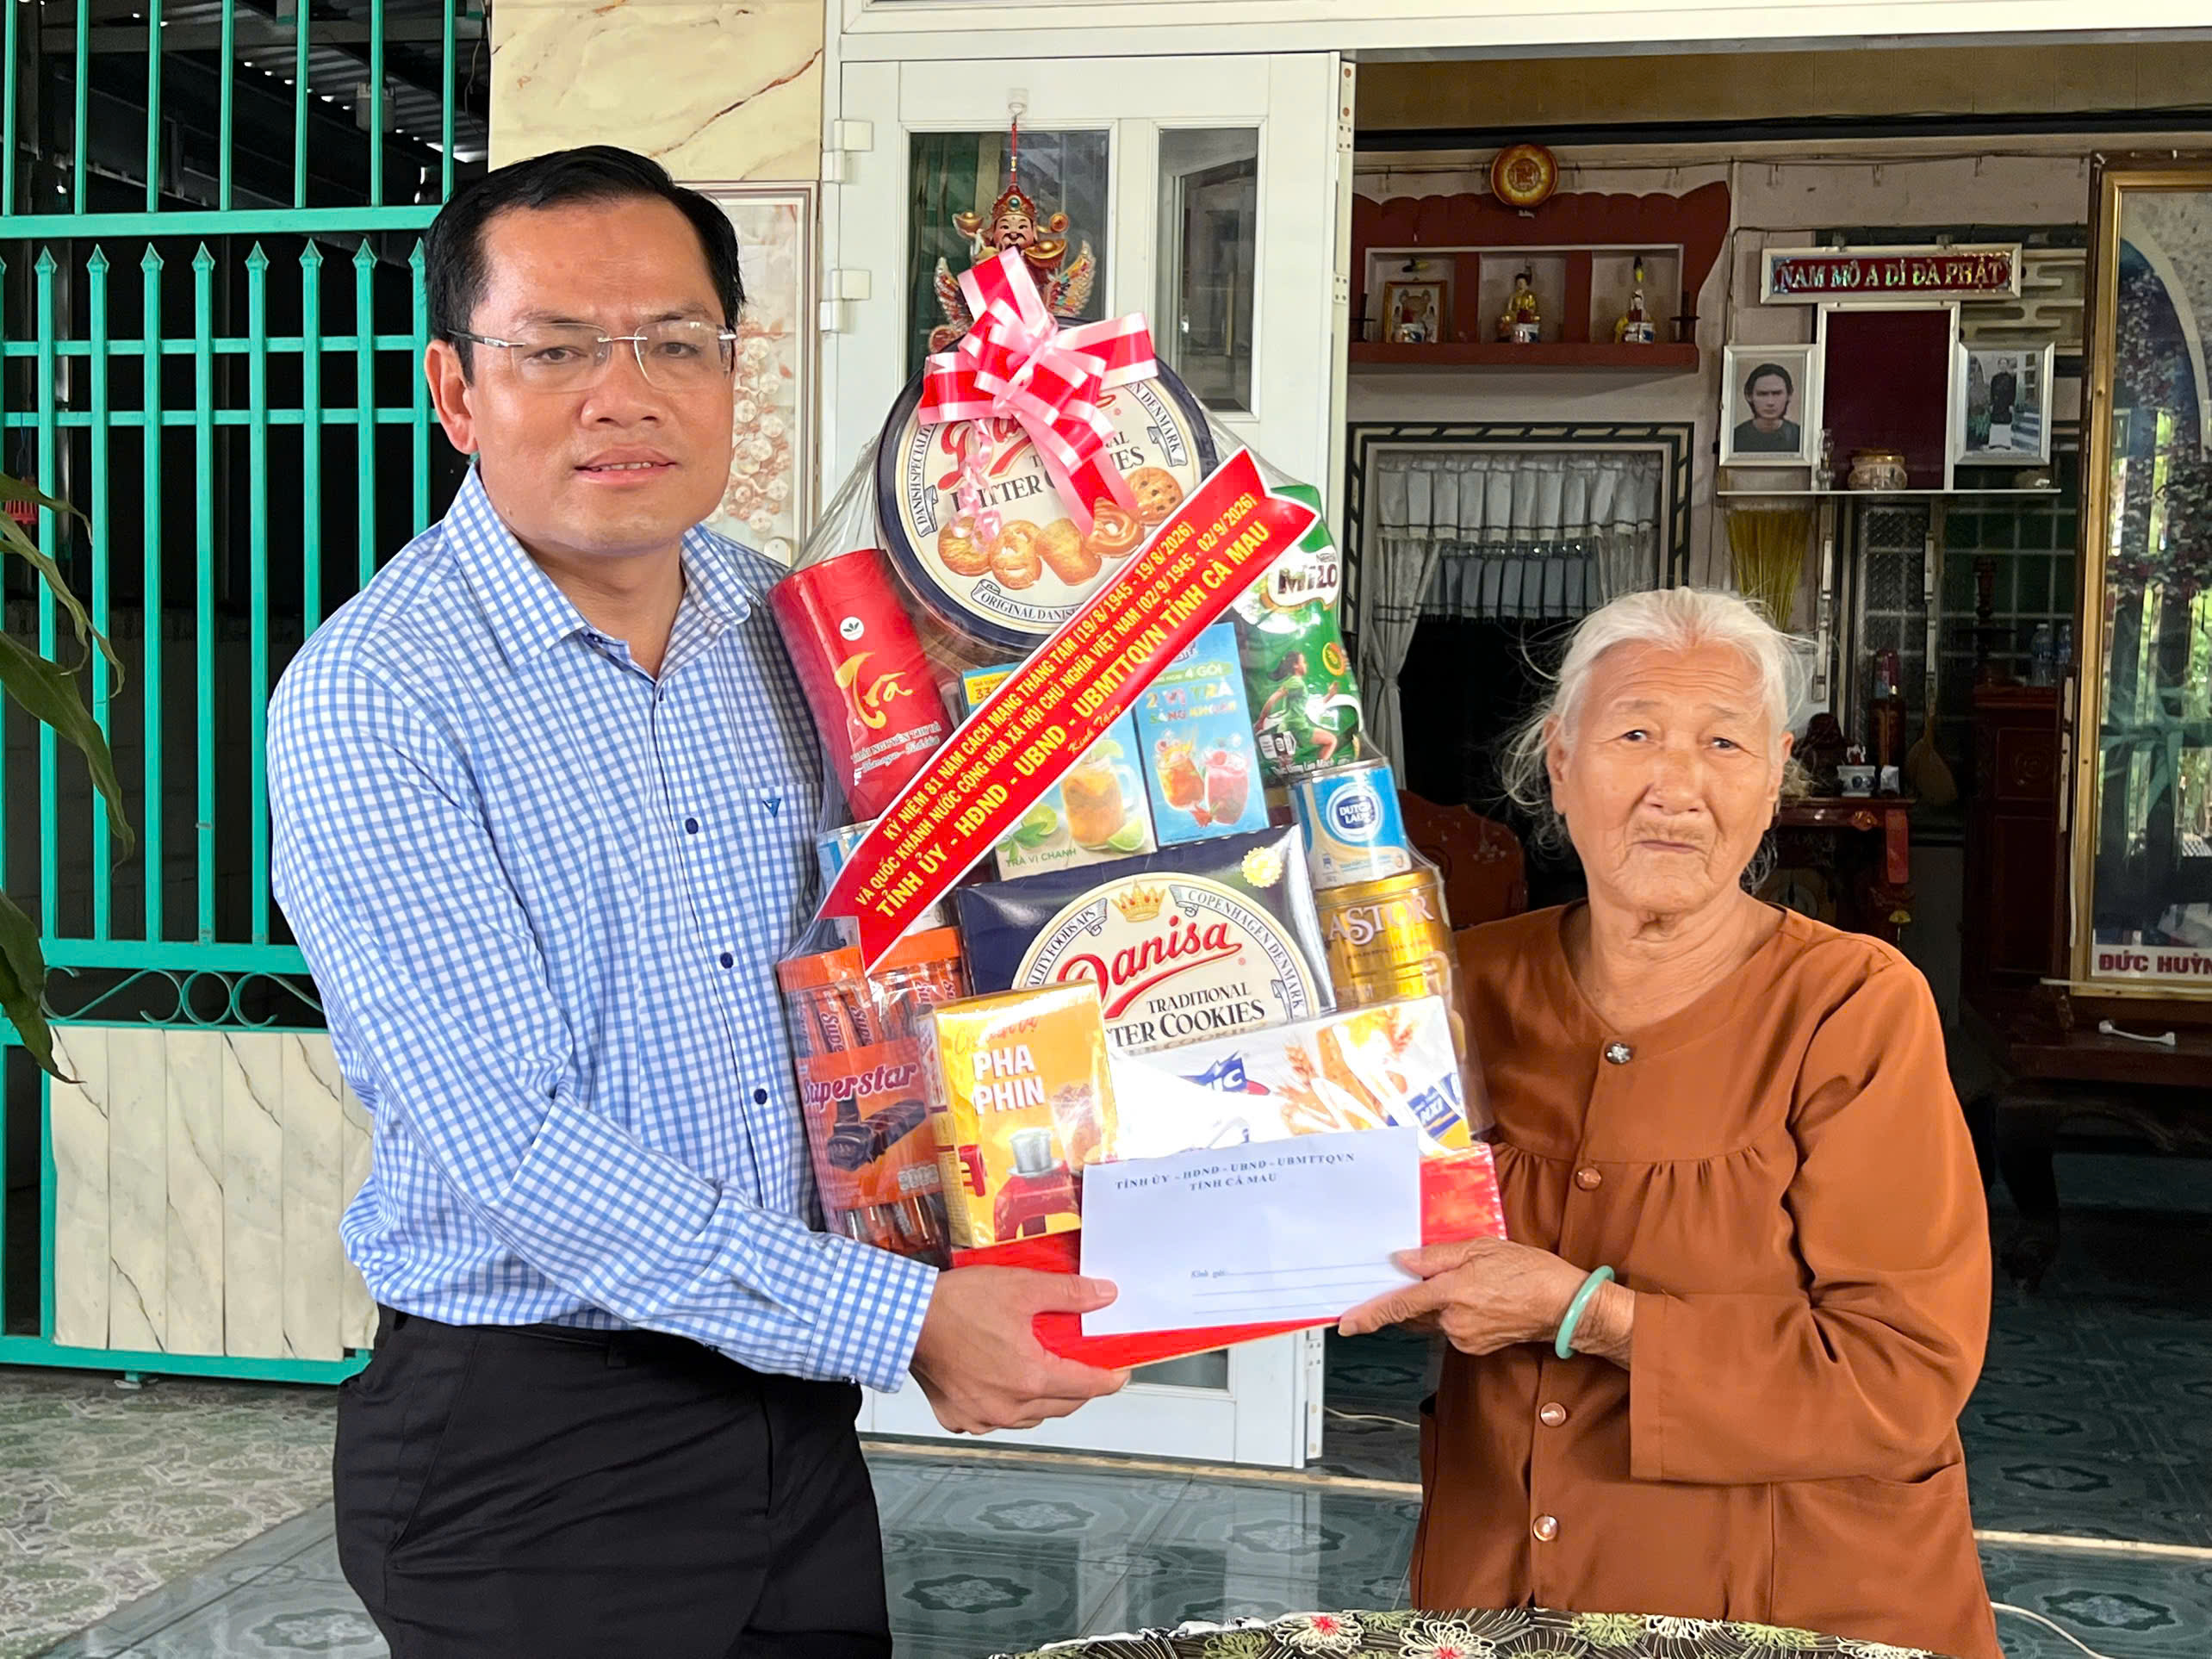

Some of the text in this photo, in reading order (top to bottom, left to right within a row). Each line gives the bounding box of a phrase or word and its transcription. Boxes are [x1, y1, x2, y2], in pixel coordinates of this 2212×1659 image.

[1780, 263, 1825, 289] NAM
[1830, 259, 1861, 288] MÔ
[1864, 264, 1879, 287] A
[1944, 258, 2003, 289] PHẬT
[1140, 391, 1181, 453] DENMARK
[910, 482, 928, 525] DANISH
[950, 475, 1043, 513] TTER
[981, 592, 1035, 619] ORIGINAL
[883, 818, 902, 841] KỶ
[898, 792, 929, 823] NIỆM
[924, 777, 943, 794] 81
[937, 751, 966, 779] NĂM
[961, 723, 993, 755] CÁCH
[988, 693, 1023, 728] MẠNG
[1016, 660, 1056, 696] THÁNG
[1049, 637, 1078, 664] TÁM
[1073, 581, 1133, 643] (19/8/1945
[1135, 521, 1195, 581] 19/8/2026)
[1184, 667, 1194, 679] 4
[855, 887, 874, 904] VÀ
[871, 857, 900, 889] QUỐC
[896, 819, 935, 860] KHÁNH
[929, 790, 961, 823] NƯỚC
[958, 761, 990, 792] CỘNG
[983, 740, 1011, 765] HÒA
[1006, 722, 1026, 744] XÃ
[1020, 705, 1045, 729] HỘI
[1039, 680, 1065, 710] CHỦ
[1061, 655, 1096, 689] NGHĨA
[1089, 631, 1116, 658] VIỆT
[1113, 607, 1141, 636] NAM
[1137, 553, 1196, 613] (02/9/1945
[1196, 493, 1258, 551] 02/9/2026)
[876, 871, 923, 916] TỈNH
[916, 843, 948, 873] ỦY
[954, 785, 1008, 837] HĐND
[1014, 725, 1066, 775] UBND
[1072, 624, 1168, 717] UBMTTQVN
[1160, 584, 1208, 629] TỈNH
[1202, 559, 1233, 588] CÀ
[1225, 520, 1269, 565] MAU
[1146, 692, 1158, 708] 2
[1005, 848, 1077, 868] TRÀ VỊ CHANH
[1327, 896, 1436, 946] ASTOR
[1028, 952, 1052, 986] ALITY
[1056, 915, 1242, 1018] Danisa
[1187, 889, 1304, 1010] COPENHAGEN DENMARK
[2097, 949, 2212, 975] ĐỨC HUỲN
[1146, 982, 1253, 1015] TRADITIONAL
[1107, 998, 1266, 1049] TER COOKIES
[972, 1043, 1036, 1083] PHA
[802, 1061, 918, 1112] Superstar
[972, 1075, 1046, 1117] PHIN
[1230, 1159, 1267, 1173] UBND
[1277, 1153, 1356, 1167] UBMTTQVN
[1246, 1172, 1277, 1185] MAU
